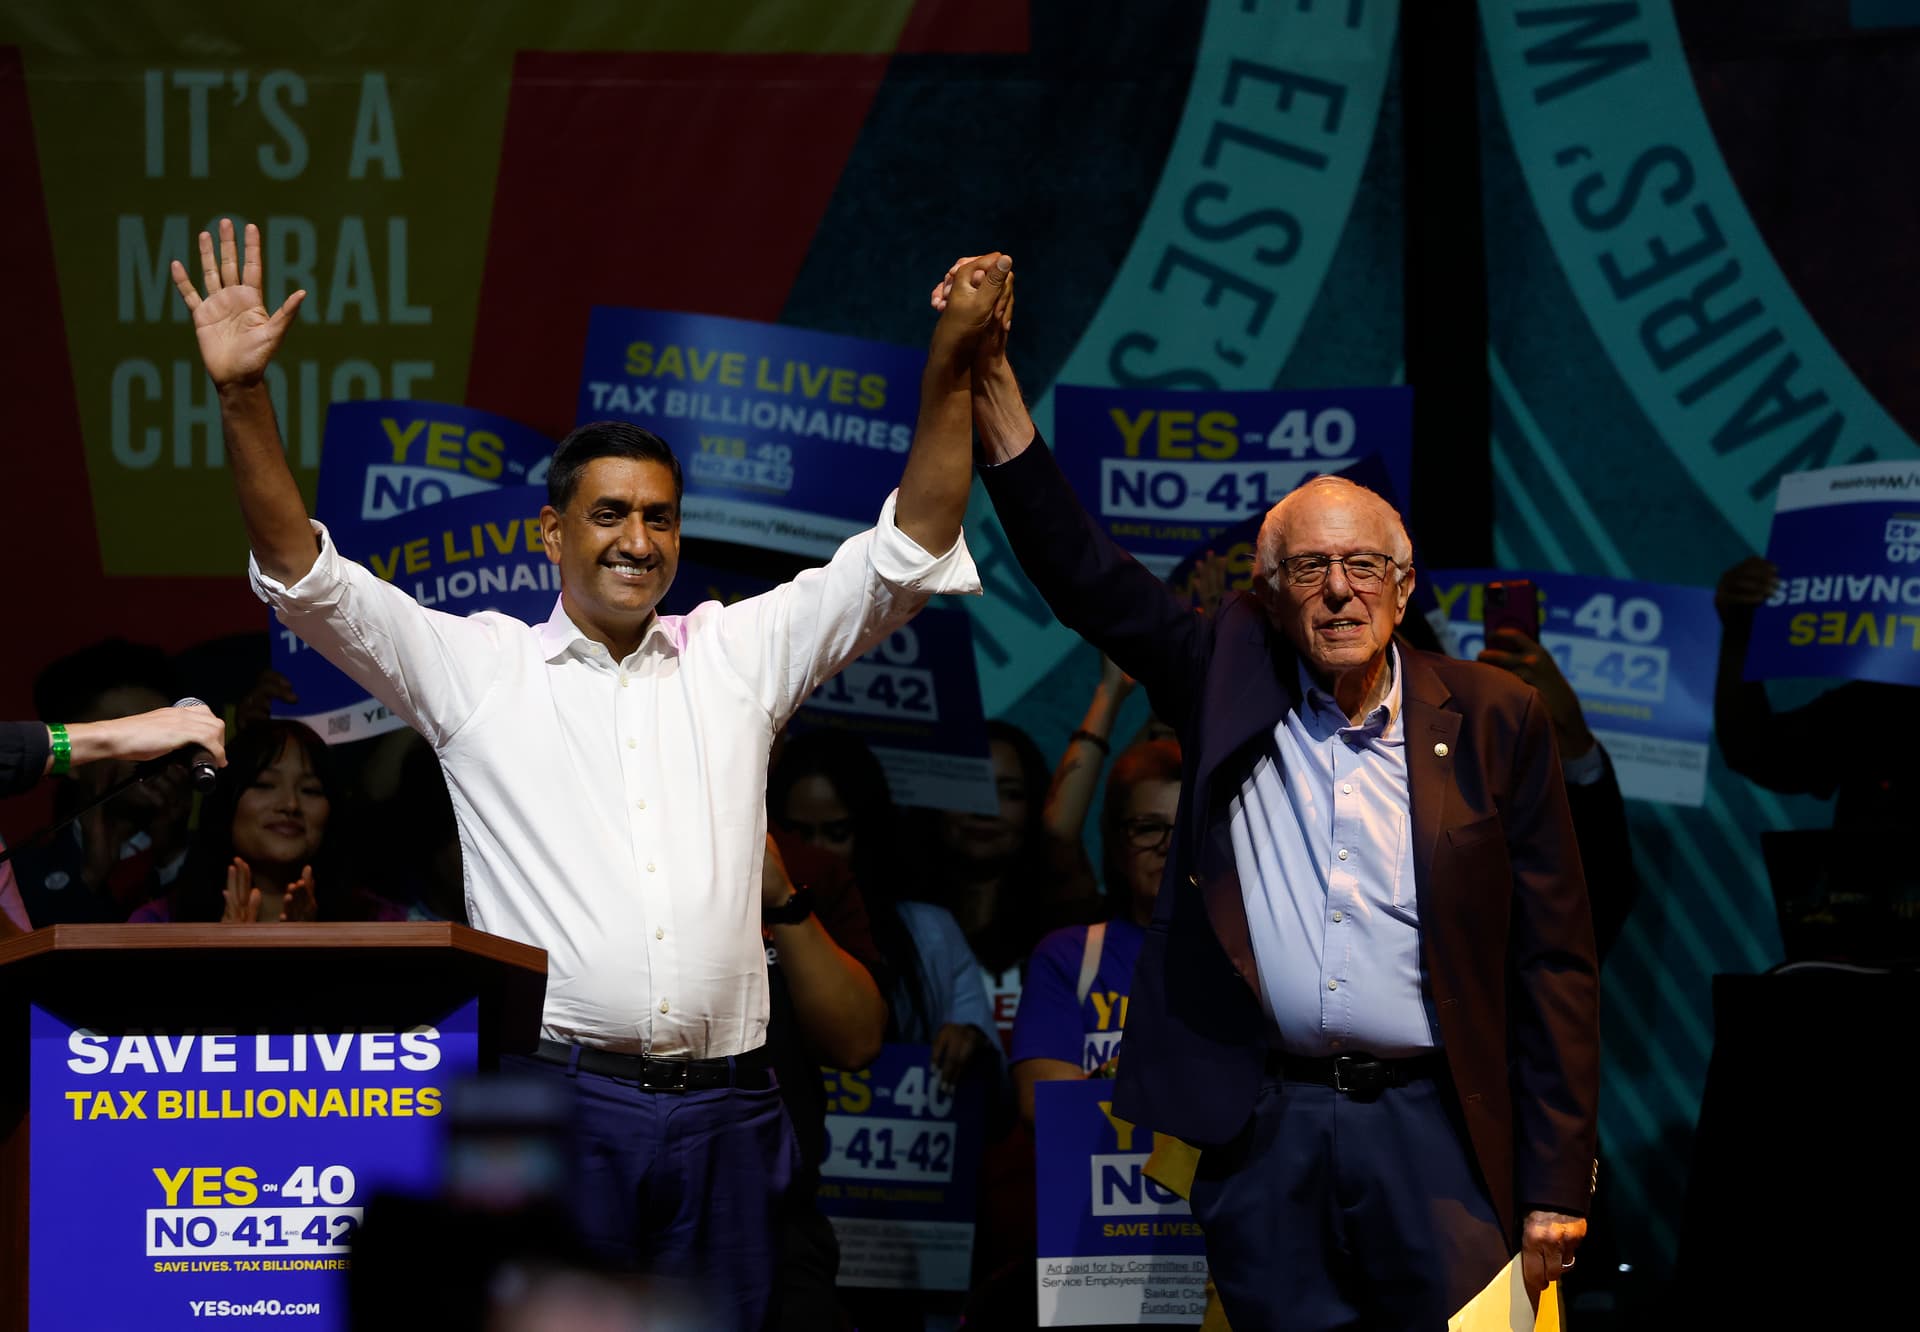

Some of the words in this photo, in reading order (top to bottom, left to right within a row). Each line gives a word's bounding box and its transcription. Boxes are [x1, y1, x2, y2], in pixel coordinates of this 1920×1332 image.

[347, 71, 404, 181] A
[117, 213, 433, 325] MRAL
[1554, 145, 1878, 501] NAIRES'
[624, 341, 746, 387] SAVE
[756, 357, 888, 411] LIVES
[587, 380, 660, 416] TAX
[663, 388, 913, 454] BILLIONAIRES
[1109, 408, 1241, 460] YES
[1266, 406, 1358, 458] 40
[380, 417, 506, 480] YES
[372, 474, 449, 511] NO
[1110, 469, 1188, 510] NO
[1206, 472, 1269, 511] 41
[369, 537, 433, 582] VE
[442, 516, 545, 565] LIVE
[415, 562, 561, 607] LIONAI
[1765, 573, 1920, 608] ONAIRES
[1573, 591, 1664, 643] 40
[1788, 610, 1920, 652] LIVES
[867, 674, 931, 712] 42
[1594, 652, 1661, 693] 42
[66, 1026, 237, 1075] SAVE
[255, 1024, 442, 1073] LIVES
[65, 1090, 148, 1121] TAX
[157, 1087, 443, 1120] BILLIONAIRES
[845, 1126, 896, 1170] 41
[908, 1131, 950, 1172] 42
[152, 1166, 259, 1207] YES
[262, 1183, 279, 1193] ON
[281, 1164, 356, 1206] 40
[154, 1216, 218, 1248] NO
[232, 1215, 289, 1248] 41
[301, 1214, 358, 1247] 42
[1103, 1223, 1150, 1238] SAVE
[153, 1261, 189, 1273] SAVE
[191, 1260, 233, 1272] LIVES.
[234, 1260, 261, 1272] TAX
[1042, 1277, 1083, 1288] Service
[1085, 1276, 1145, 1288] Employees
[1147, 1275, 1206, 1285] Internation
[1047, 1263, 1063, 1273] Ad
[1066, 1262, 1090, 1274] paid
[1092, 1262, 1108, 1273] for
[1111, 1262, 1124, 1274] by
[1127, 1261, 1189, 1272] Committee
[1141, 1302, 1187, 1314] Funding
